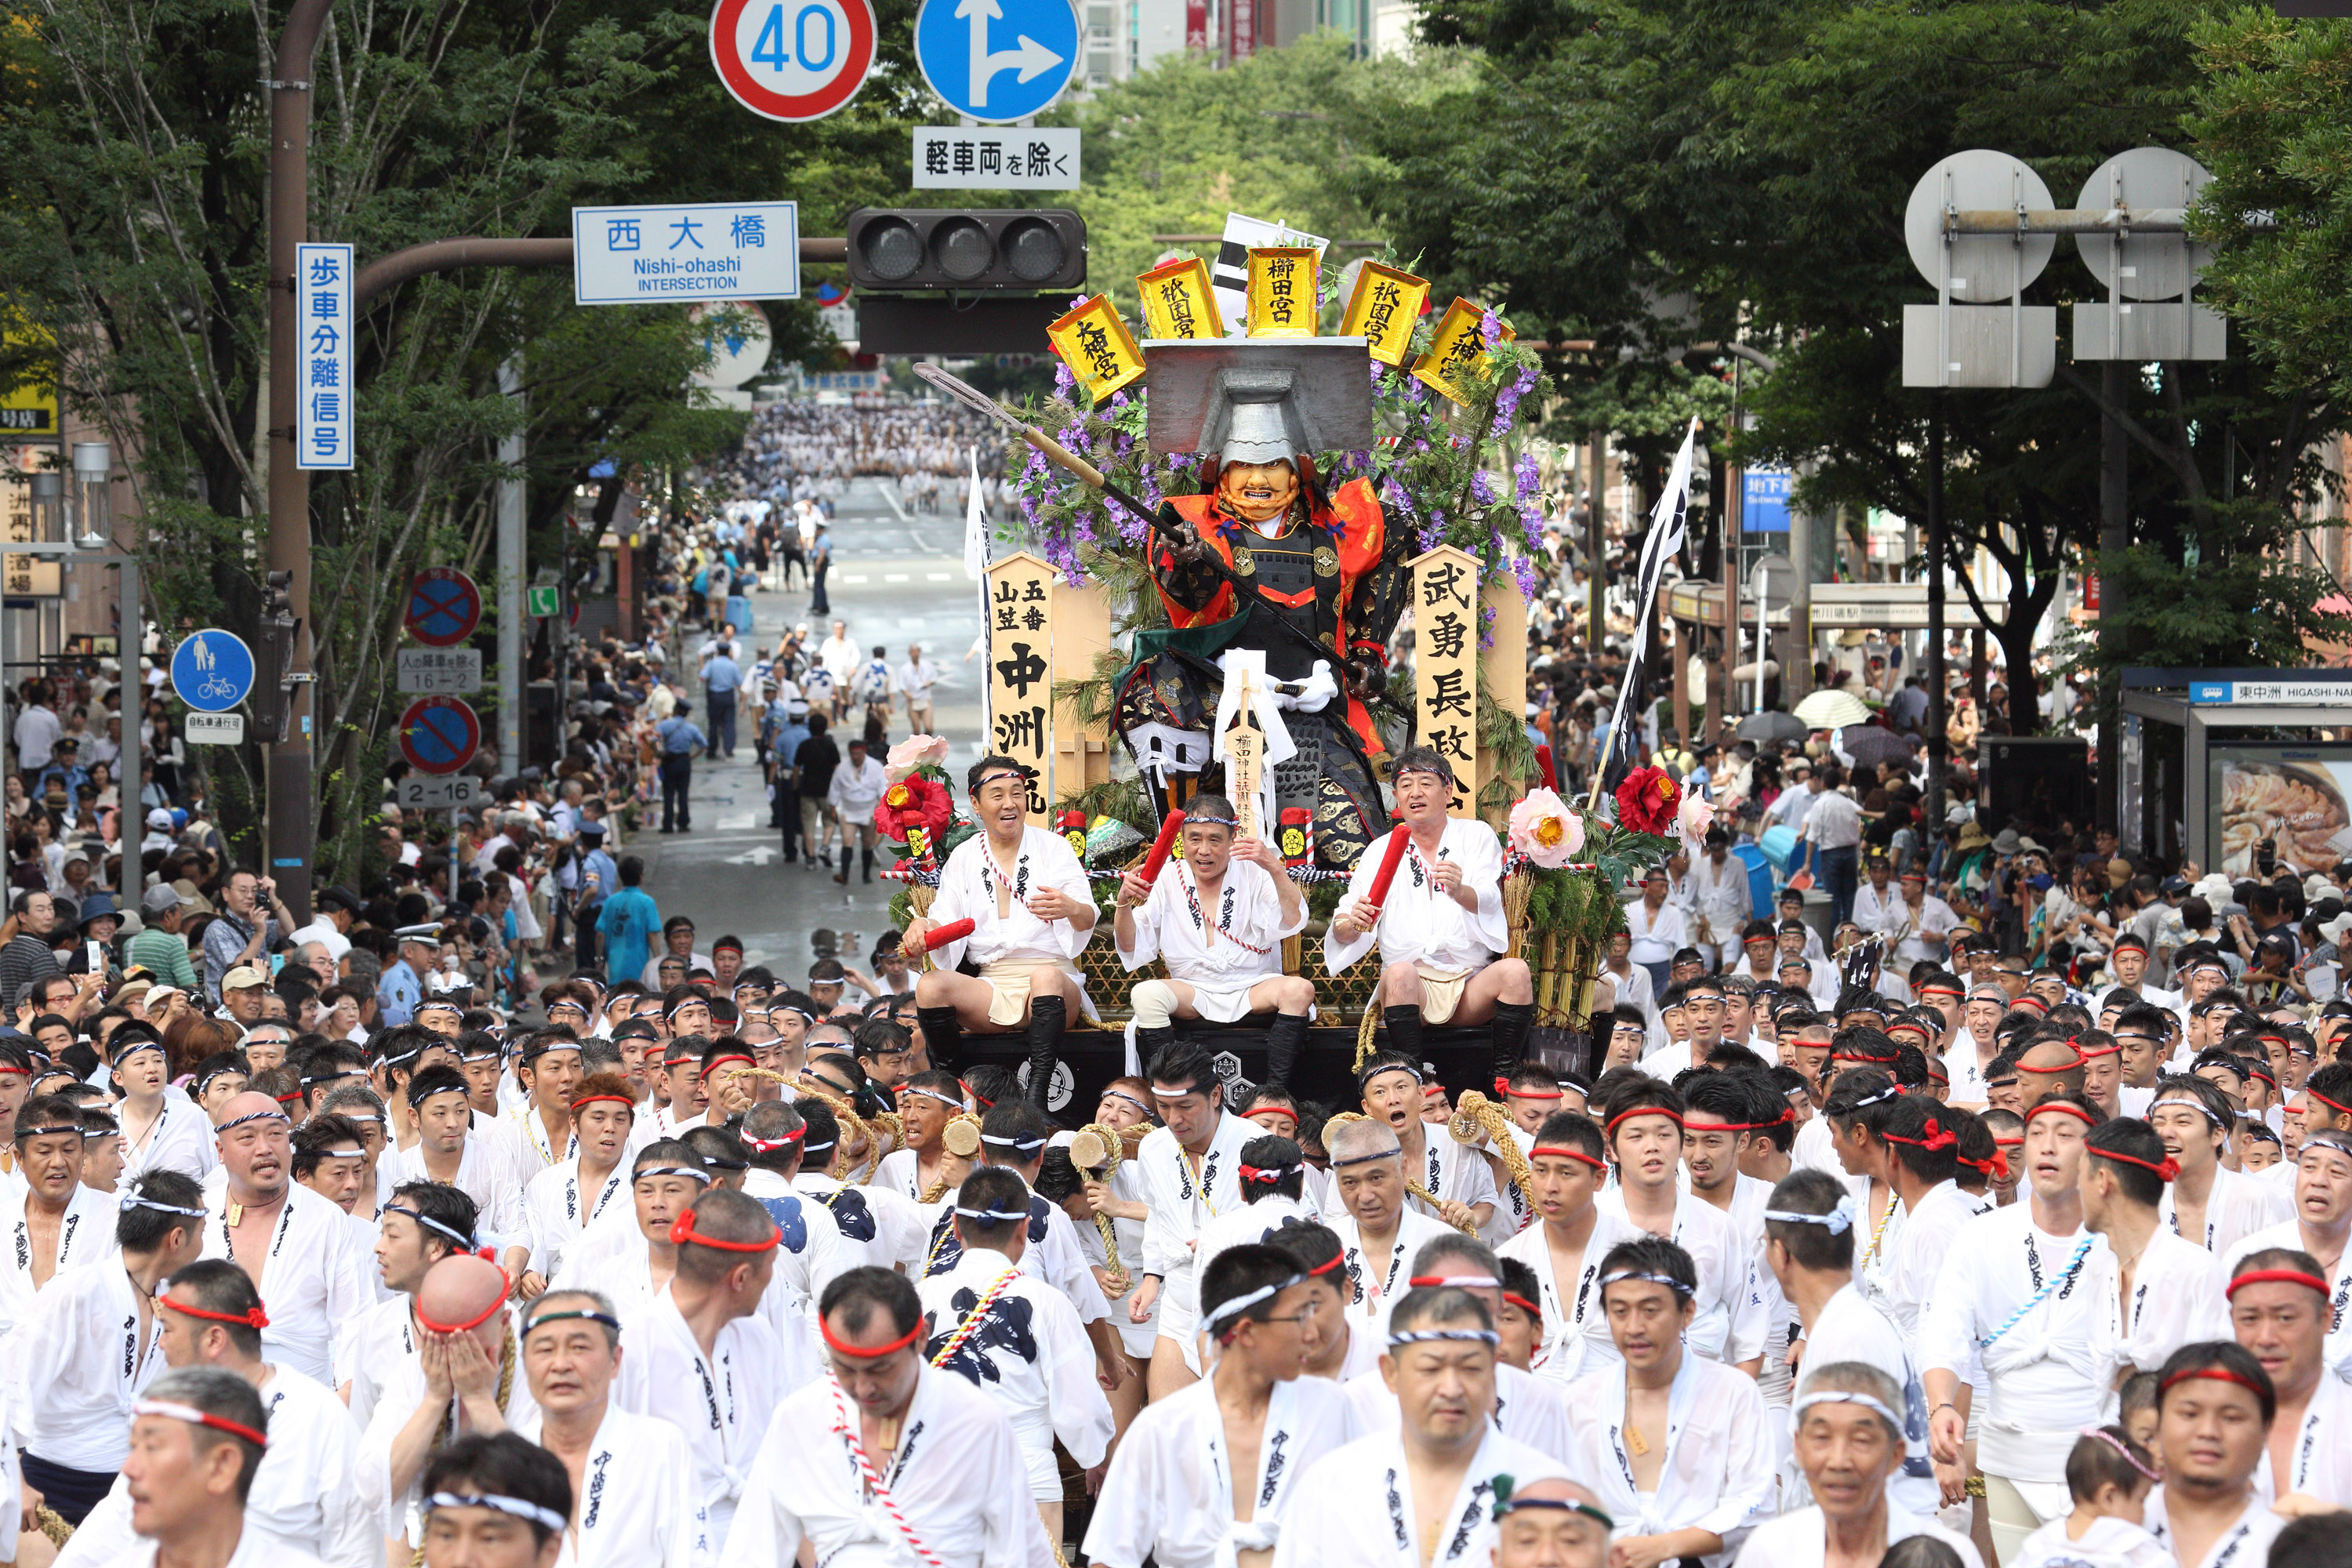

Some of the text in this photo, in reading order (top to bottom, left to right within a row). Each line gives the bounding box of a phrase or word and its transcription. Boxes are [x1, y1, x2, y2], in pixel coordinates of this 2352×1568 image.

[751, 4, 835, 72] 40
[926, 140, 1068, 177] 軽車両を除く
[607, 214, 765, 252] 西大橋
[633, 256, 741, 274] Nishi-ohashi
[638, 276, 738, 292] INTERSECTION
[1268, 257, 1295, 324] 櫛田宮
[310, 256, 339, 456] 歩車分離信号
[1076, 320, 1120, 381] 大神宮
[1748, 495, 1784, 505] Subway
[993, 580, 1020, 631] 山笠
[1022, 579, 1047, 631] 五番
[2239, 686, 2281, 699] 東中洲
[189, 717, 240, 728] 自転車通行可
[408, 783, 469, 803] 2-16
